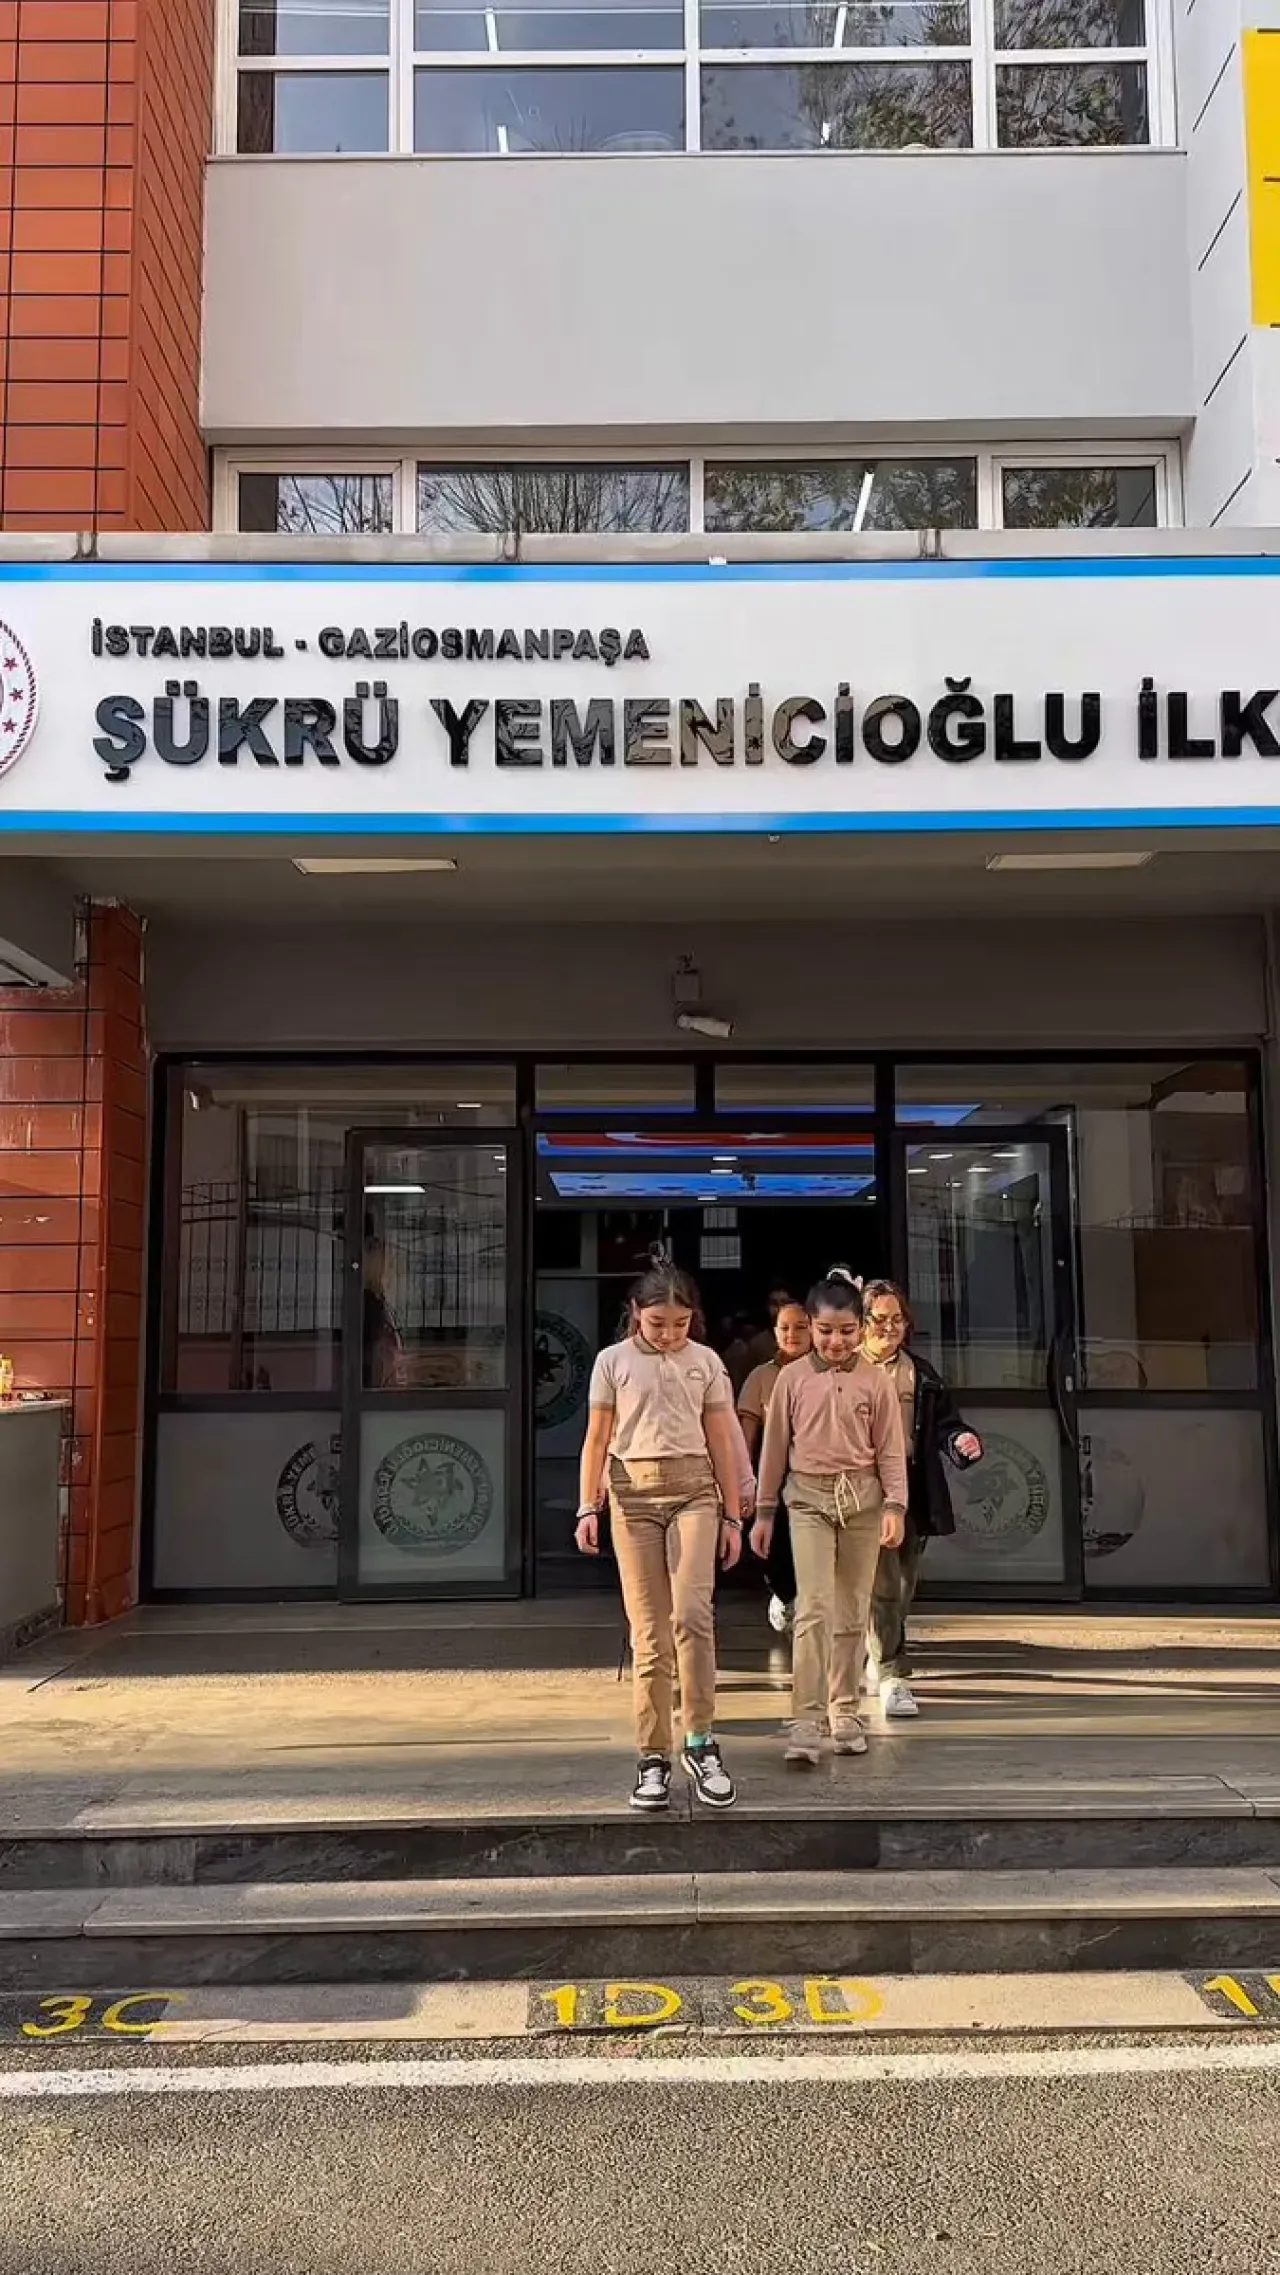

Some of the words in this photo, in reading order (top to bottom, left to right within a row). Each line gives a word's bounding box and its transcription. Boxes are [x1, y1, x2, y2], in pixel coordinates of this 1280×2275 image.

[92, 617, 284, 660] İSTANBUL
[318, 621, 650, 667] GAZİOSMANPAŞA
[92, 679, 400, 783] ŞÜKRÜ
[429, 676, 1101, 768] YEMENİCİOĞLU
[22, 1992, 184, 2037] 3C
[541, 1982, 683, 2028] 1D
[729, 1978, 885, 2024] 3D
[1203, 1975, 1280, 2017] 1
